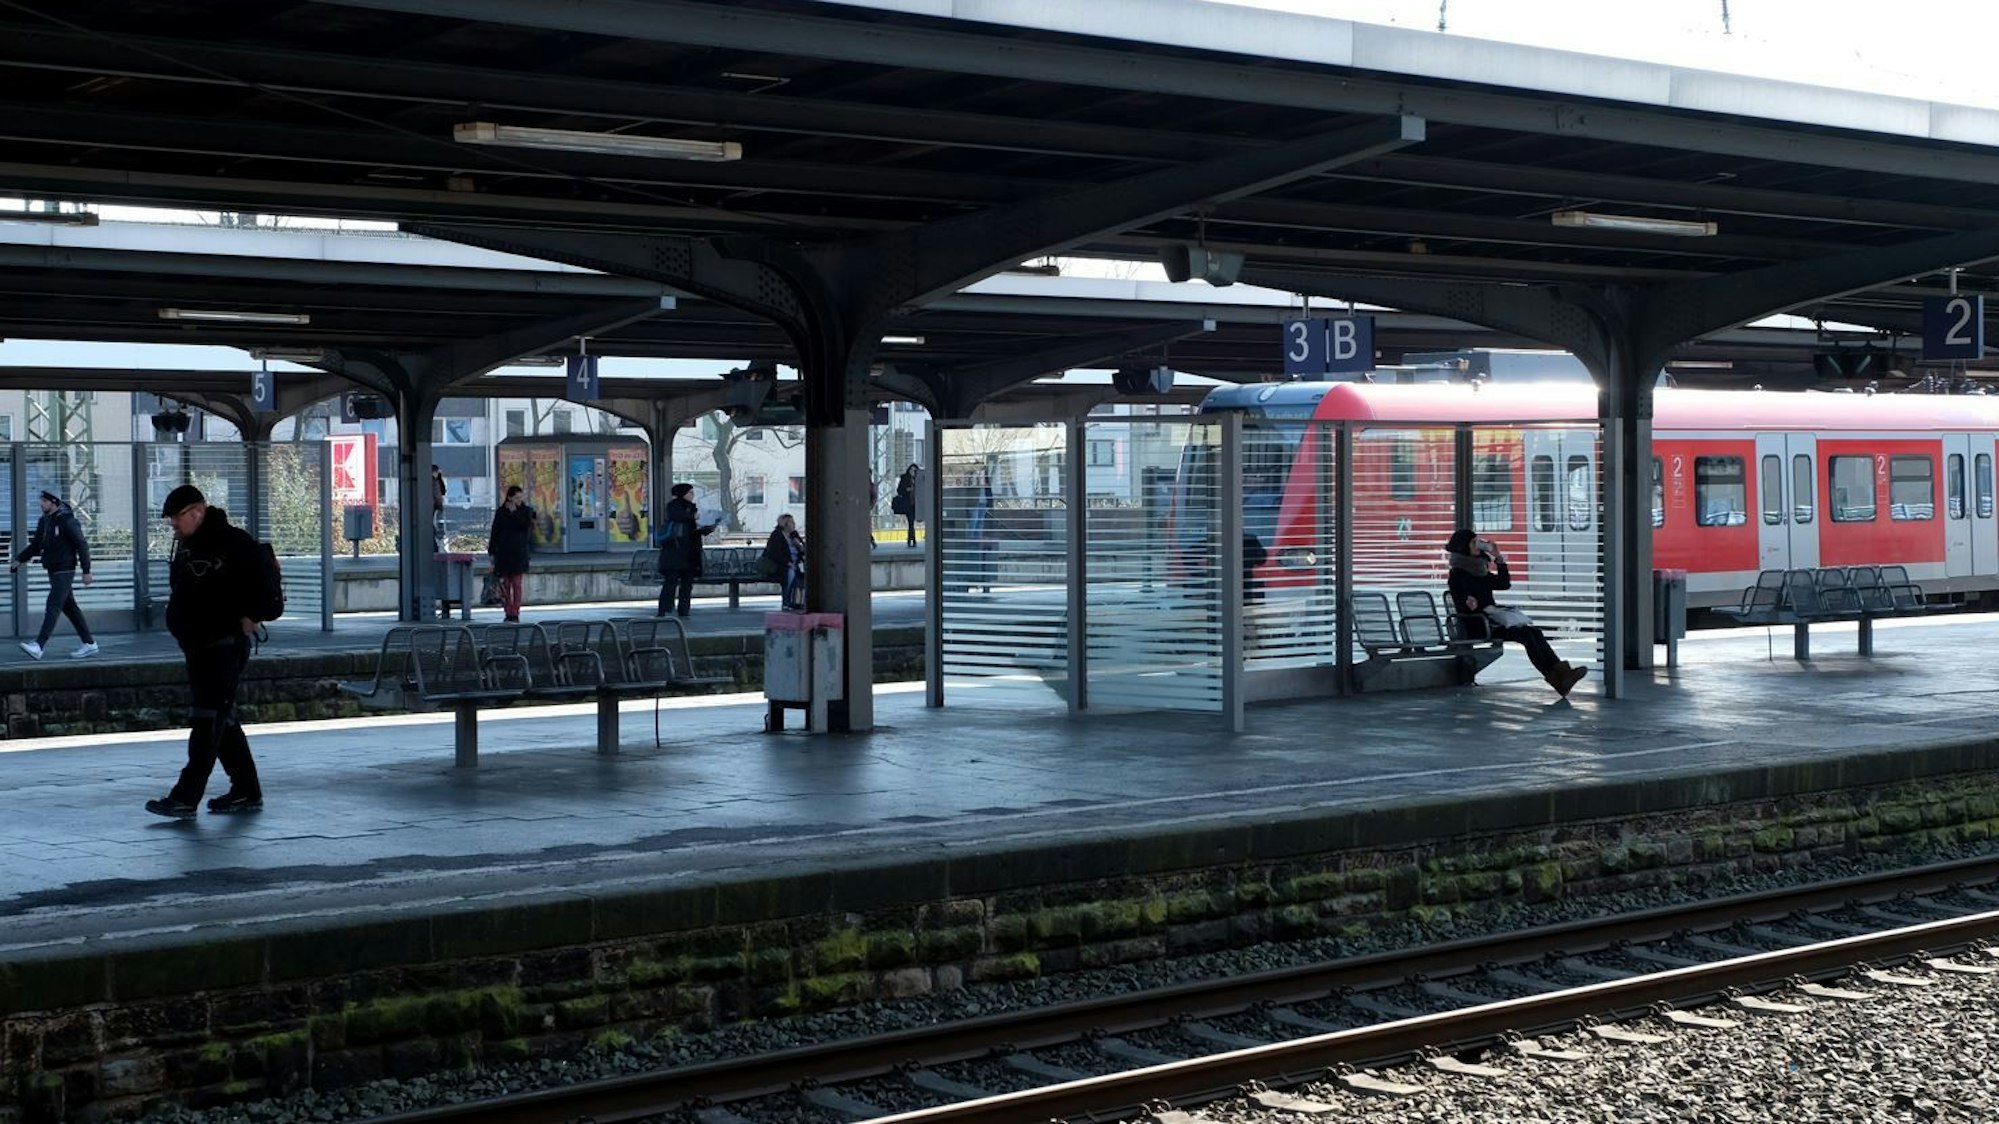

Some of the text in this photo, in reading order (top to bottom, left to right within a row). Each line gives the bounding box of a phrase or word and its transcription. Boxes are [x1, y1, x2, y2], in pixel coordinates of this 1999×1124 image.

[1945, 299, 1972, 344] 2
[1289, 320, 1357, 362] 3 B
[577, 358, 590, 389] 4
[254, 376, 265, 402] 5
[346, 394, 355, 418] 6
[333, 442, 356, 489] K
[1673, 456, 1683, 477] 2
[1877, 455, 1886, 475] 2
